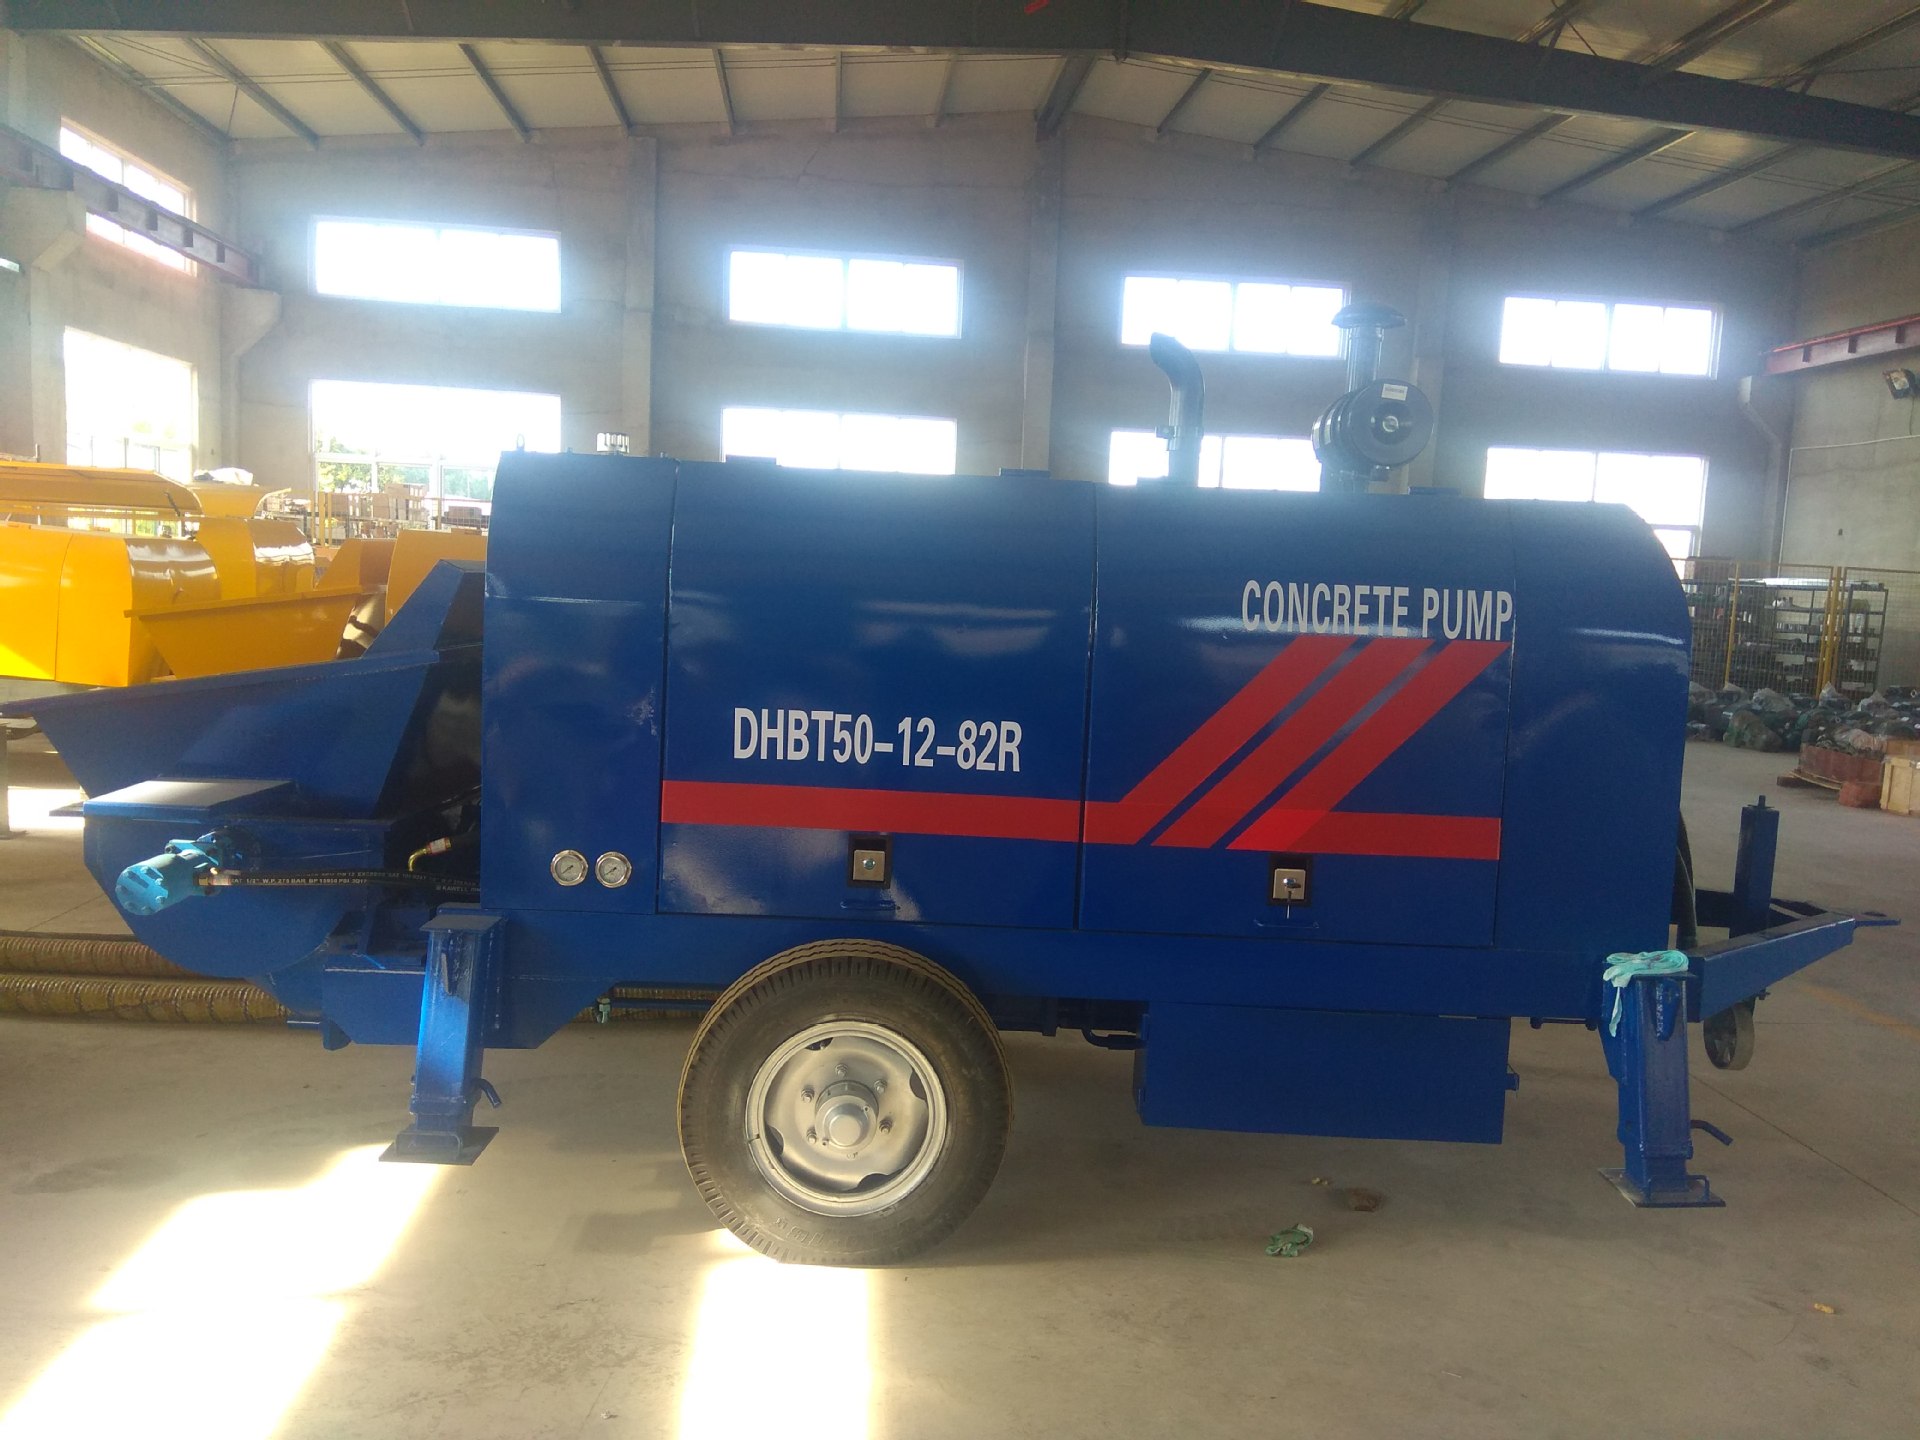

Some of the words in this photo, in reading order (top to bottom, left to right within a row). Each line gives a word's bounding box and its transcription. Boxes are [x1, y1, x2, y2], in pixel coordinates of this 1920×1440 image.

[1241, 579, 1410, 637] CONCRETE
[1421, 587, 1514, 641] PUMP
[733, 707, 1023, 773] DHBT50-12-82R
